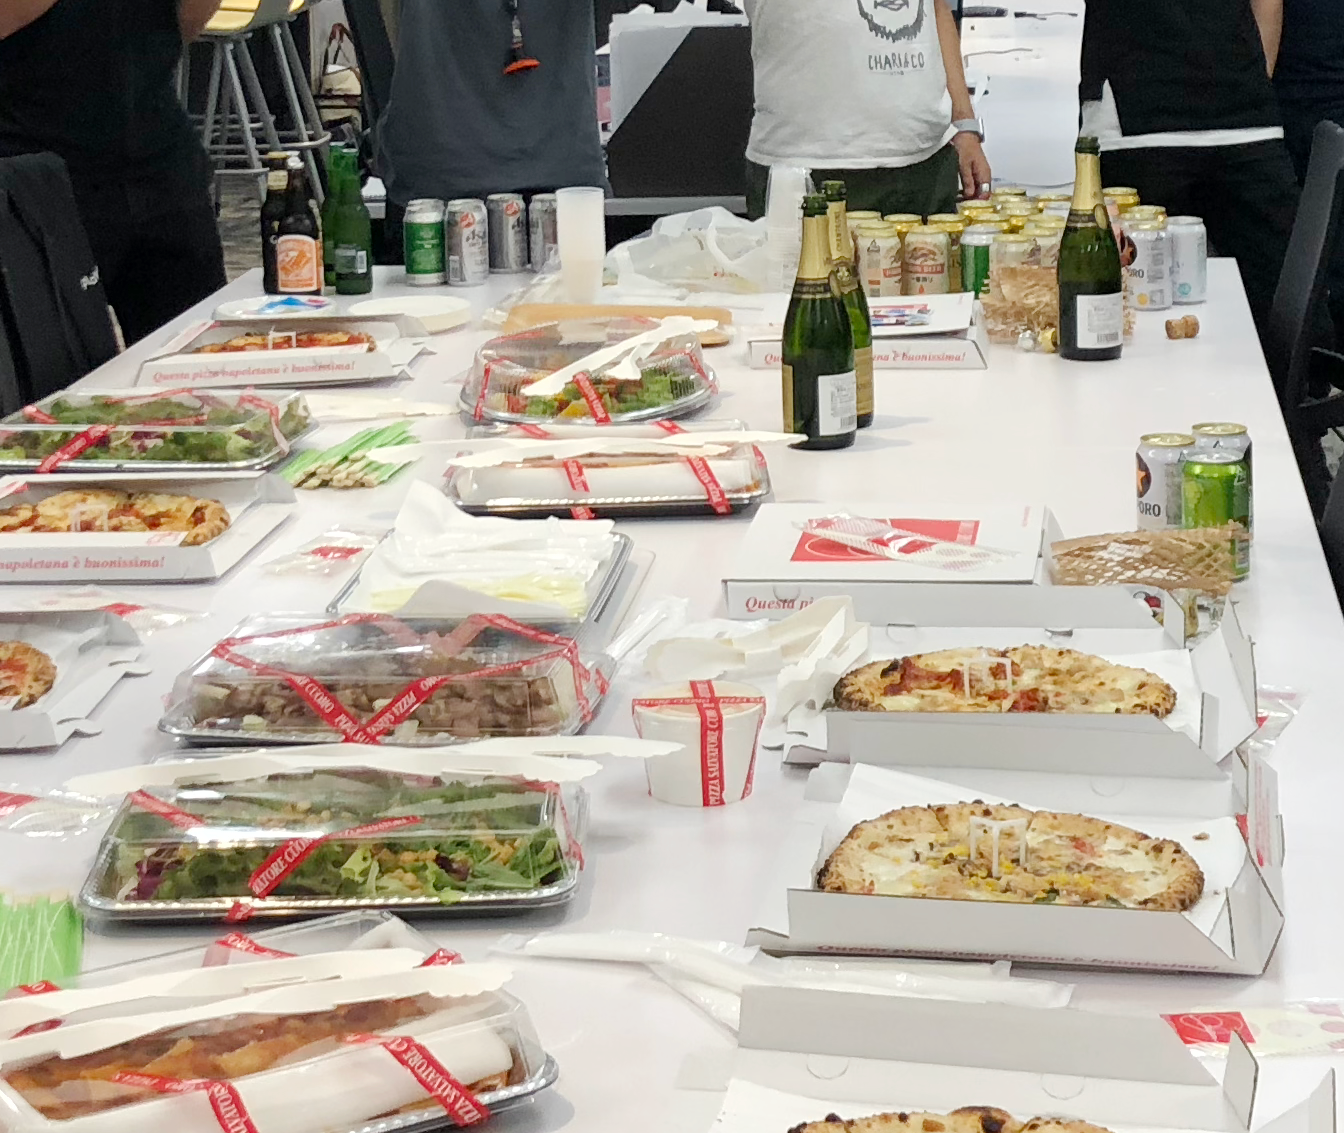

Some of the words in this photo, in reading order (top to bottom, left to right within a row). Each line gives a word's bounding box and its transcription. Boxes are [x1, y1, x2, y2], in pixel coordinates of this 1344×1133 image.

[84, 555, 165, 569] buonissima!
[745, 596, 797, 613] Questa
[404, 1045, 461, 1104] SALVATORE
